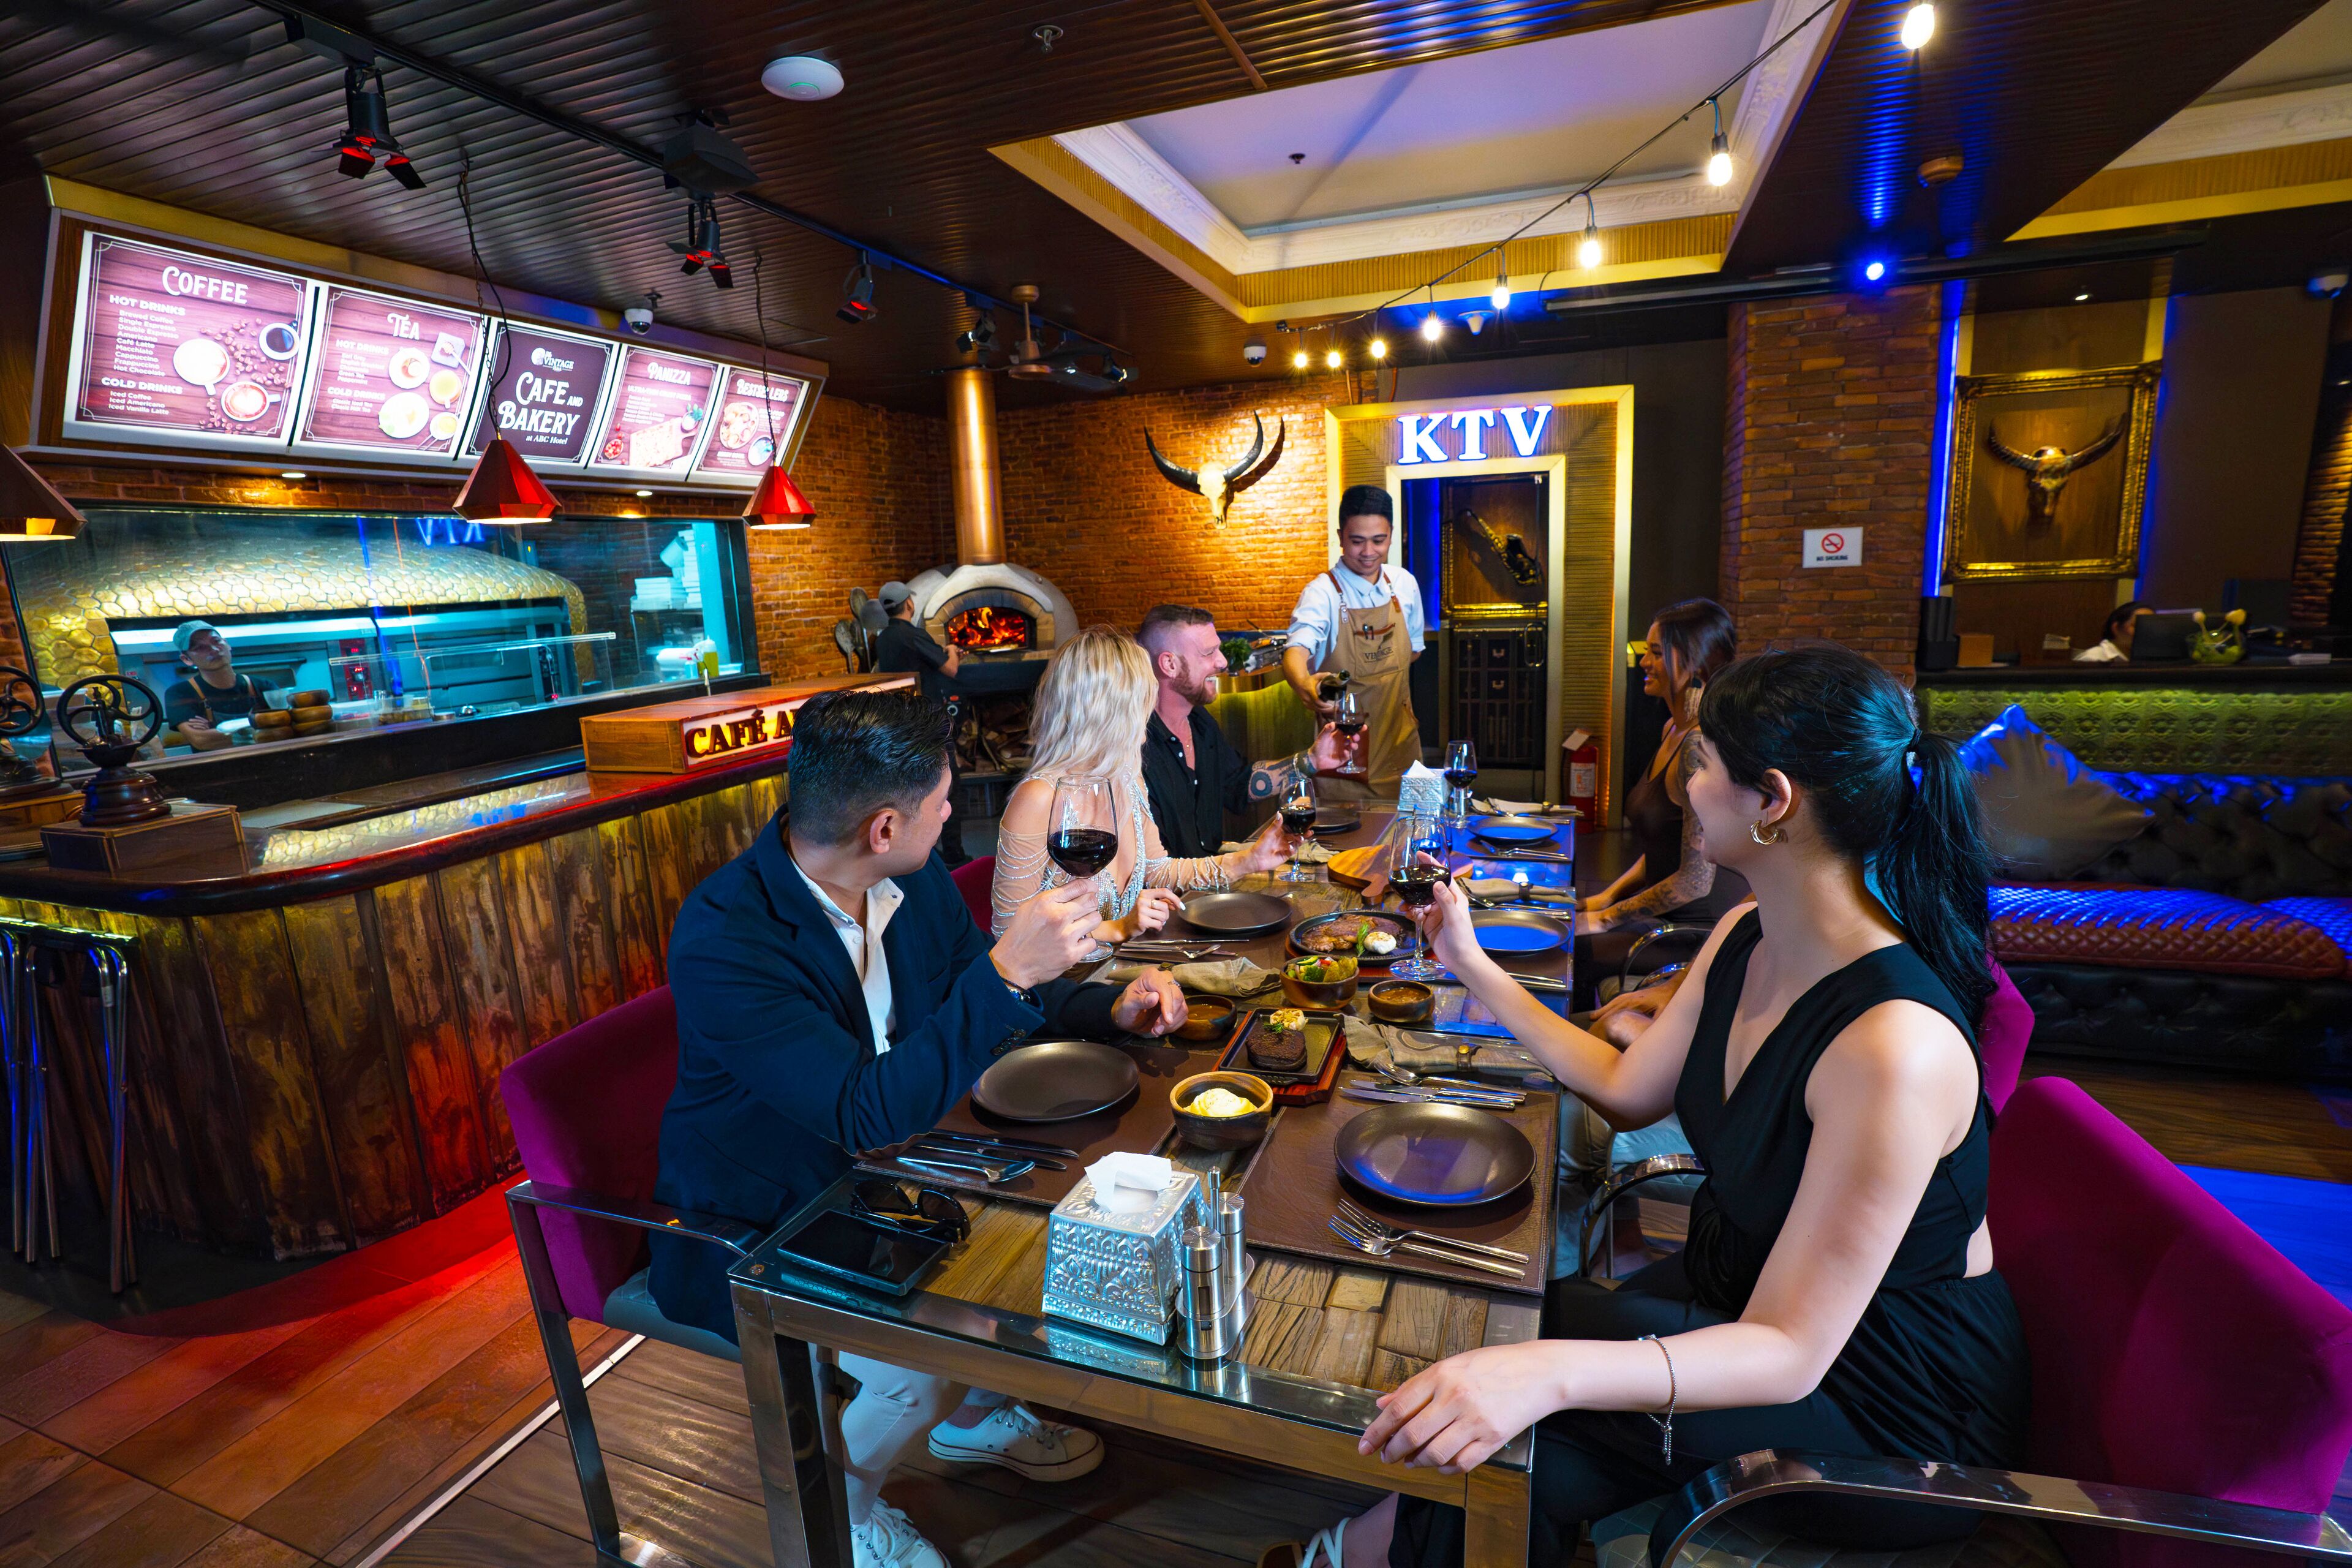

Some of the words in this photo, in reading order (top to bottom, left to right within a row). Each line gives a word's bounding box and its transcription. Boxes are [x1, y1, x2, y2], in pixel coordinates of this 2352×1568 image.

[162, 266, 249, 304] COFFEE
[110, 295, 137, 307] HOT
[140, 300, 186, 316] DRINKS
[119, 309, 148, 320] Brewed
[149, 315, 174, 325] Coffee
[119, 317, 142, 326] Single
[144, 321, 176, 333] Espresso
[118, 323, 146, 334] Double
[146, 328, 179, 340] Espresso
[387, 313, 420, 340] TEA
[118, 331, 157, 342] Americano
[116, 344, 154, 355] Macchiato
[336, 339, 356, 349] HOT
[357, 342, 389, 355] DRINKS
[115, 352, 159, 363] Cappuccino
[115, 358, 160, 369] Frappuccino
[544, 357, 575, 369] VINTAGE
[129, 367, 166, 377] Chocolate
[647, 362, 692, 386] PANIZZA
[101, 377, 136, 388] COLD
[138, 382, 183, 394] DRINKS
[516, 372, 570, 405] CAFE
[567, 396, 583, 407] AND
[328, 387, 353, 397] COLD
[353, 390, 386, 401] DRINKS
[127, 399, 165, 408] Americano
[498, 401, 581, 435] BAKERY
[550, 436, 568, 445] Hotel
[1397, 405, 1553, 465] KTV
[685, 709, 767, 758] CAFÉ
